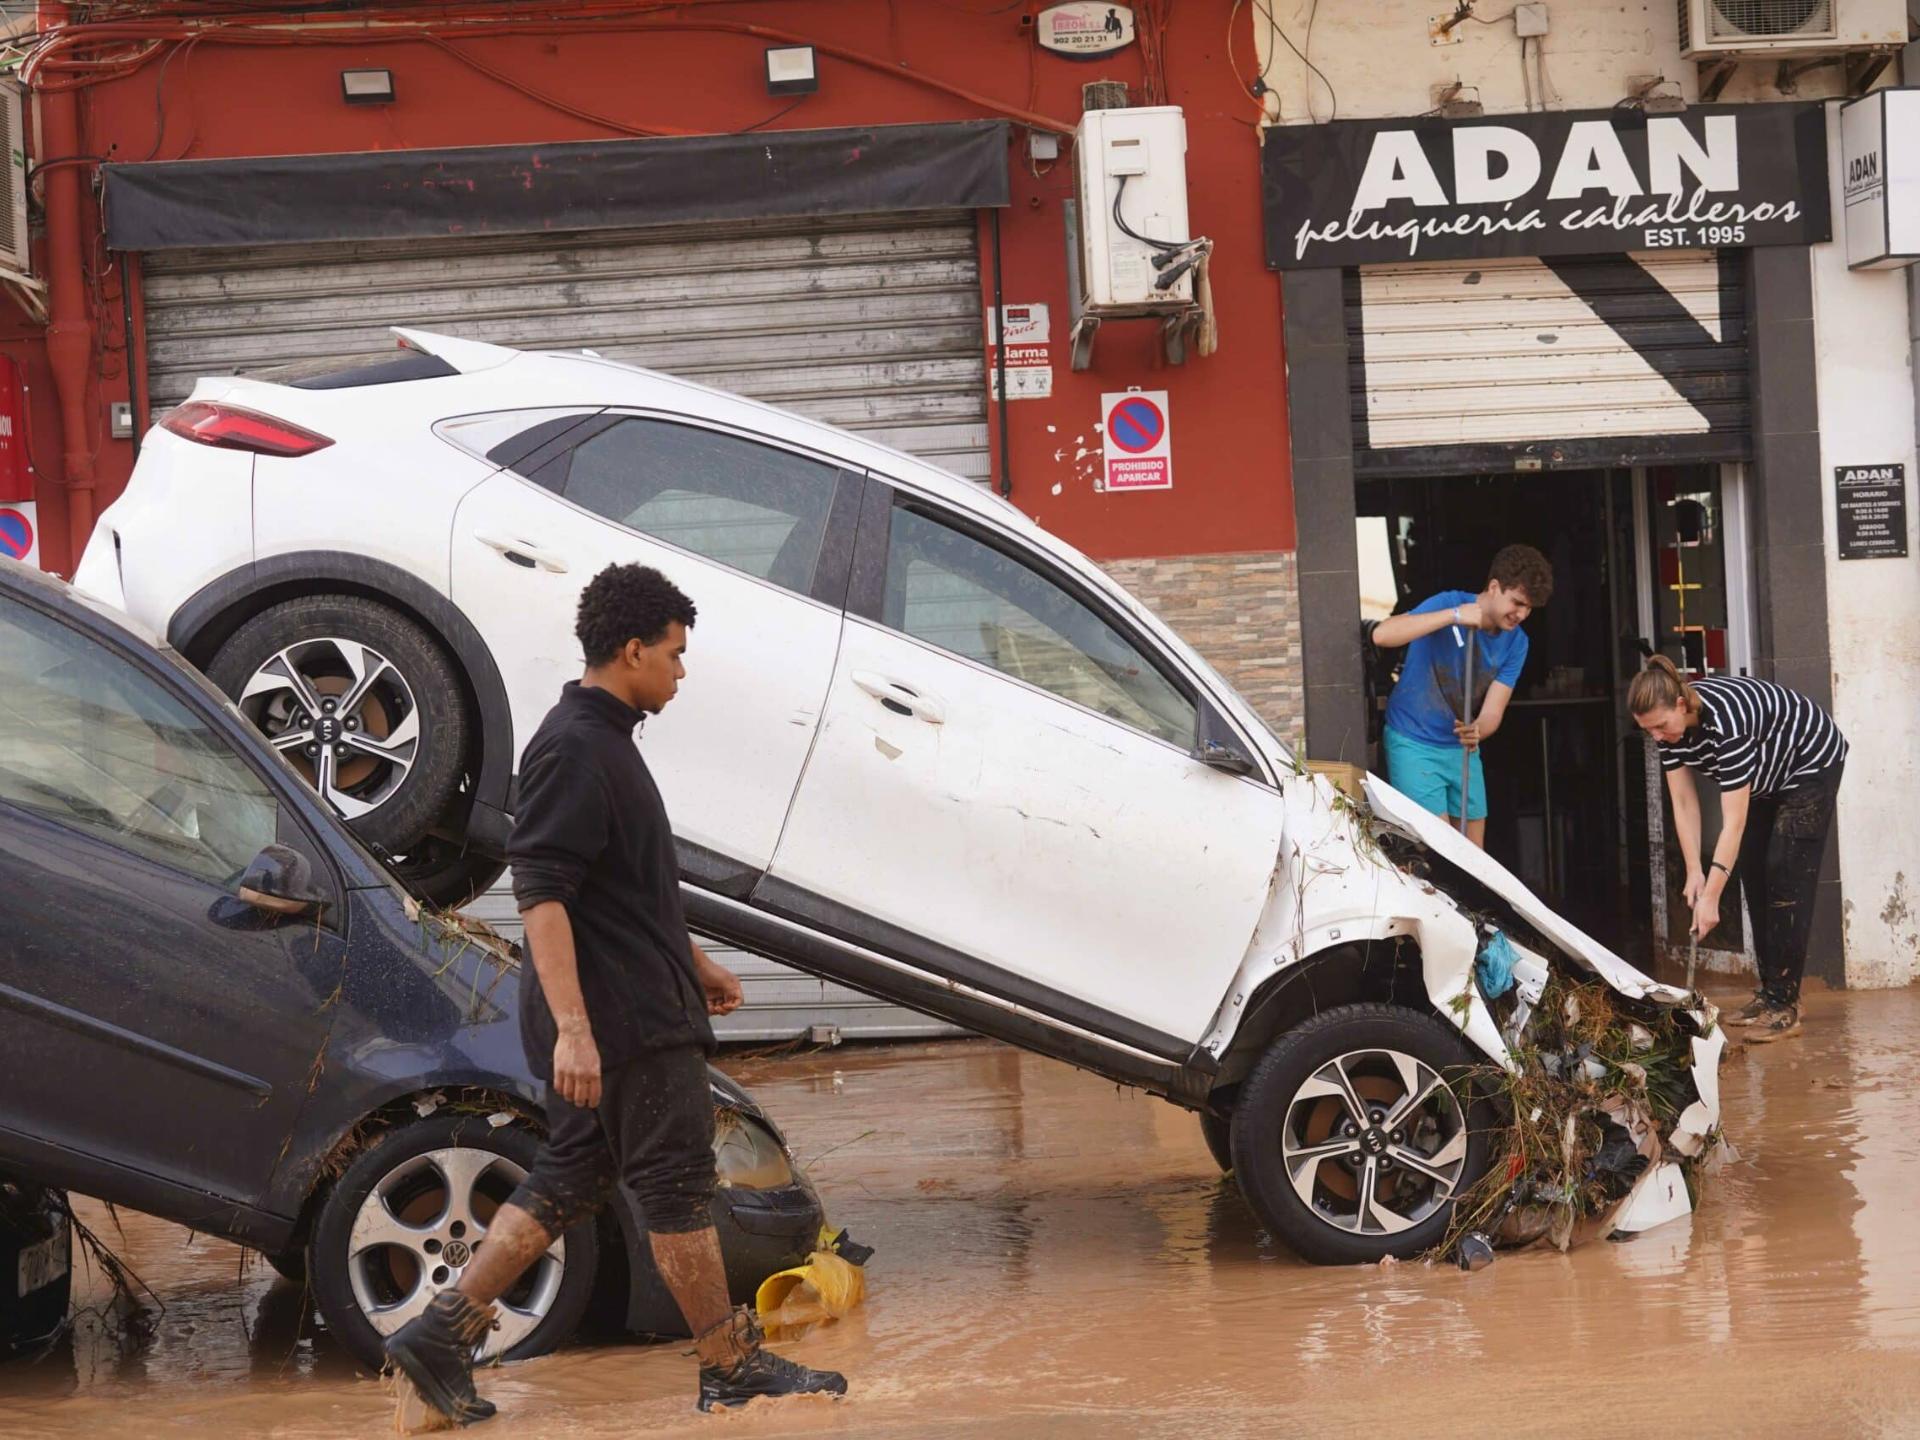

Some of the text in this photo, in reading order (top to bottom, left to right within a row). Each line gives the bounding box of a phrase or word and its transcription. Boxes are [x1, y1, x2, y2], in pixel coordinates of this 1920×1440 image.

[1351, 115, 1739, 211] ADAN
[1849, 151, 1877, 185] ADAN
[1295, 186, 1801, 260] peluquería caballeros
[1645, 226, 1746, 247] EST. 1995
[1112, 460, 1164, 472] PROHIBIDO
[1116, 471, 1161, 482] APARCAR
[1844, 469, 1893, 481] ADAN
[322, 720, 332, 740] KIA
[1367, 1131, 1382, 1152] KIA
